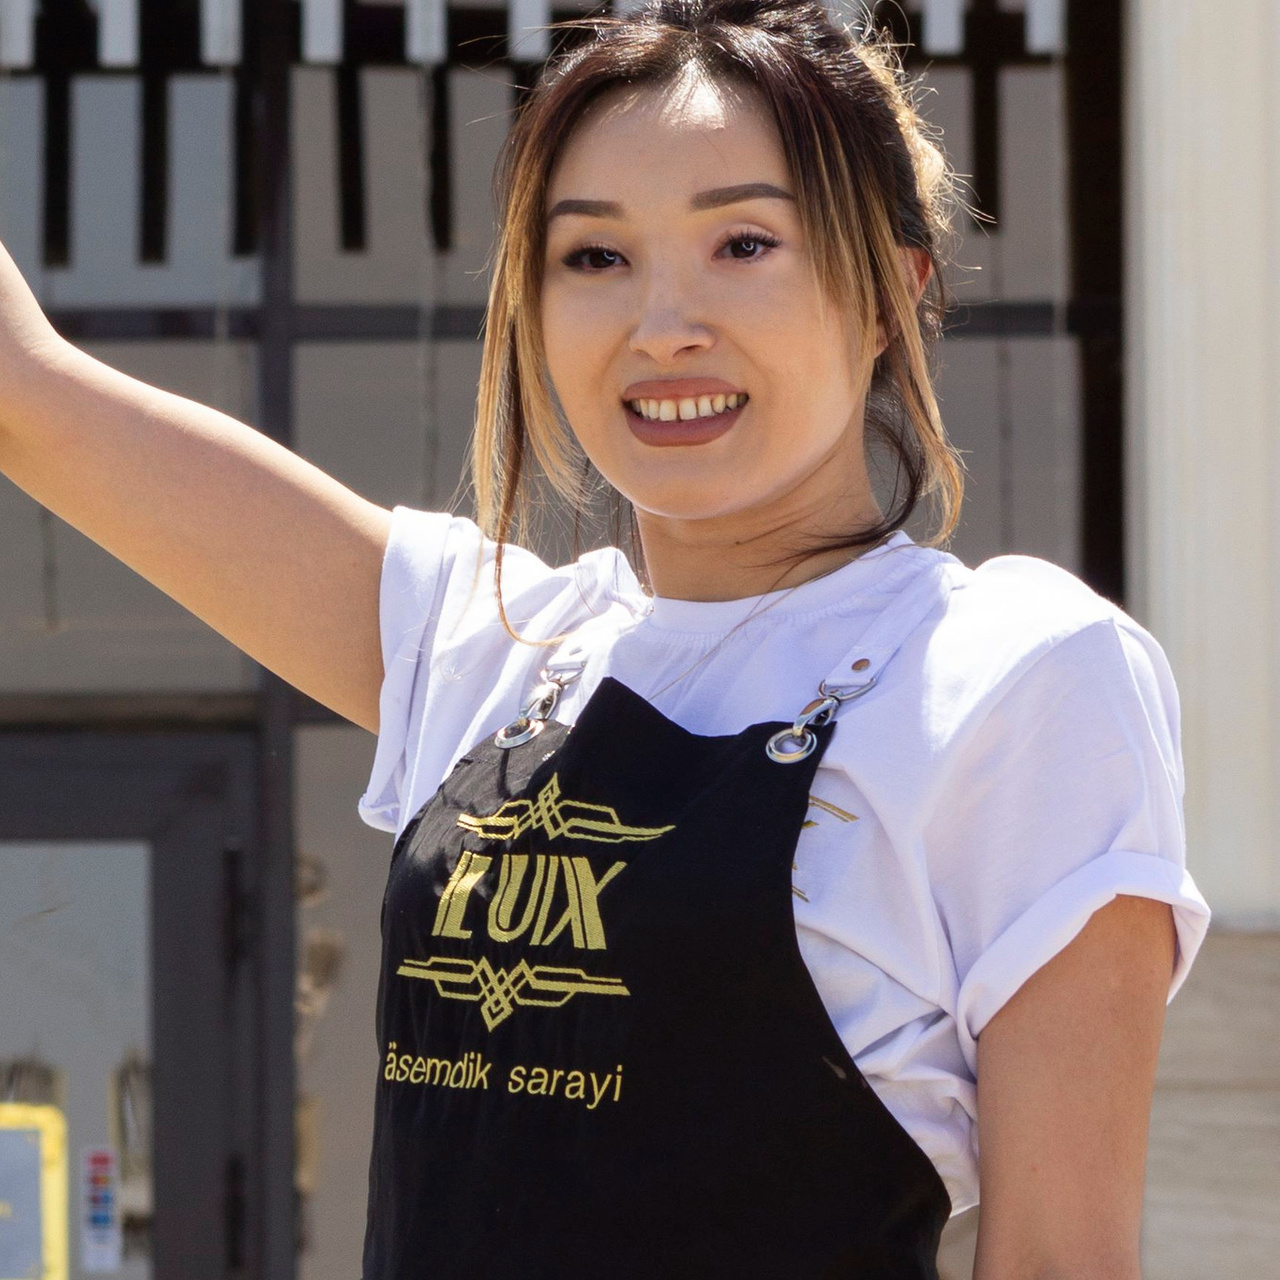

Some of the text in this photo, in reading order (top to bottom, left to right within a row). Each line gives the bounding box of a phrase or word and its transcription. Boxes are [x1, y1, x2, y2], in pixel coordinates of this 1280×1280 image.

[431, 850, 627, 951] LUX
[384, 1041, 623, 1110] äsemdik sarayi
